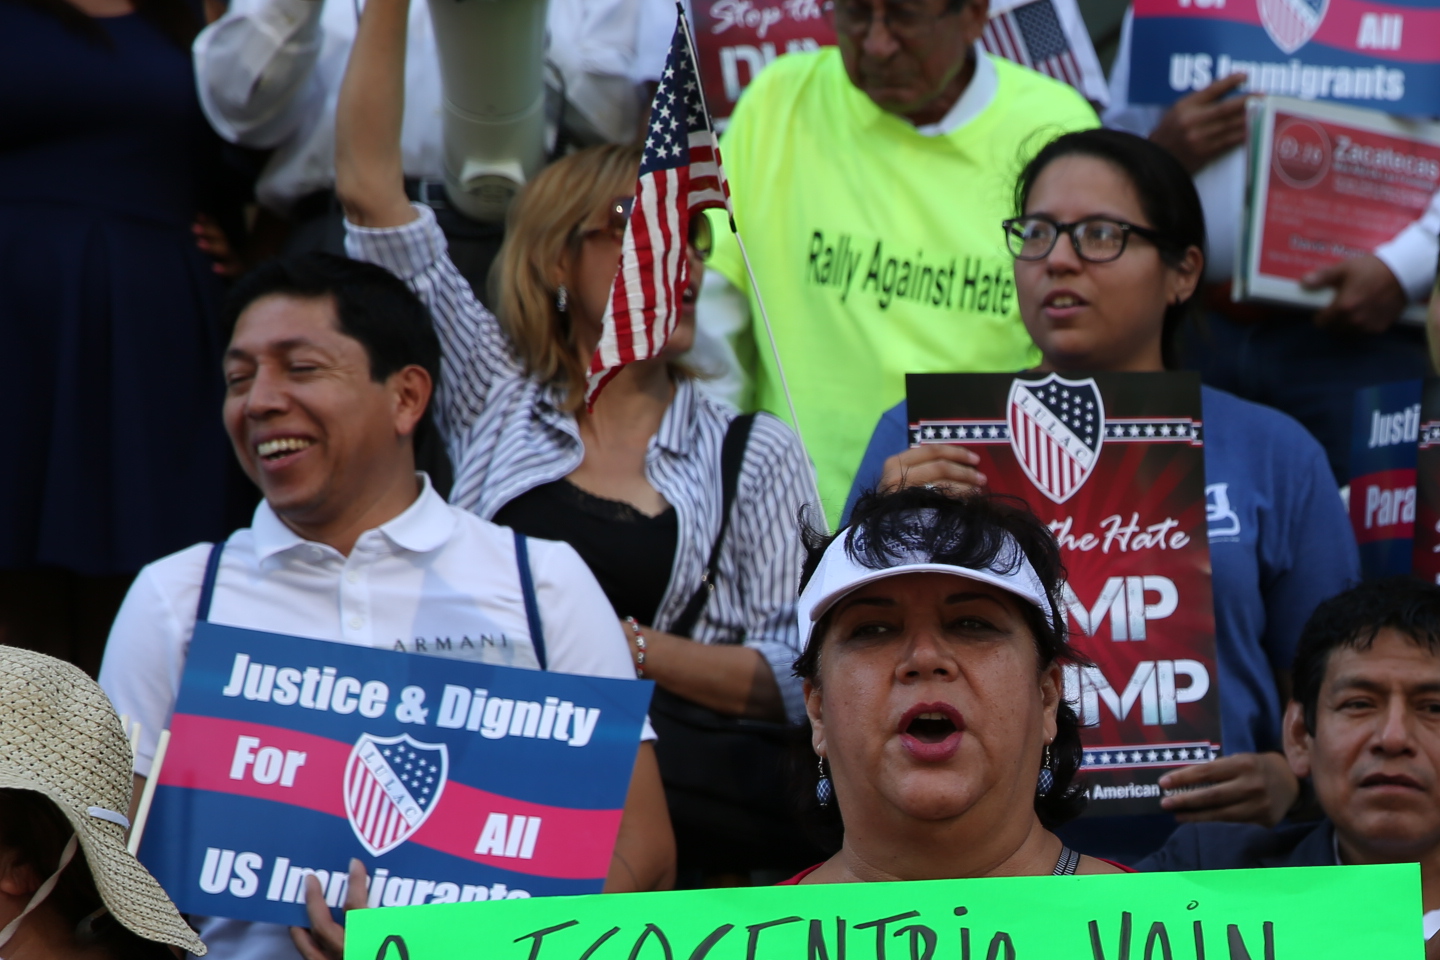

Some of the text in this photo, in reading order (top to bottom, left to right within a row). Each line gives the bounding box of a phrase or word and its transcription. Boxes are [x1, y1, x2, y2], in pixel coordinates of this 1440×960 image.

[1356, 12, 1404, 50] All
[1169, 52, 1213, 92] US
[1334, 134, 1440, 181] Zacatecas
[807, 230, 1015, 315] Rally Against Hate
[1020, 395, 1088, 462] LULAC
[1100, 511, 1191, 554] Hate
[393, 633, 509, 653] ARMANI
[223, 652, 601, 748] Justice & Dignity
[229, 735, 308, 788] For
[363, 750, 418, 820] LULAC
[1092, 782, 1160, 801] American
[474, 811, 543, 860] All
[199, 846, 264, 899] US
